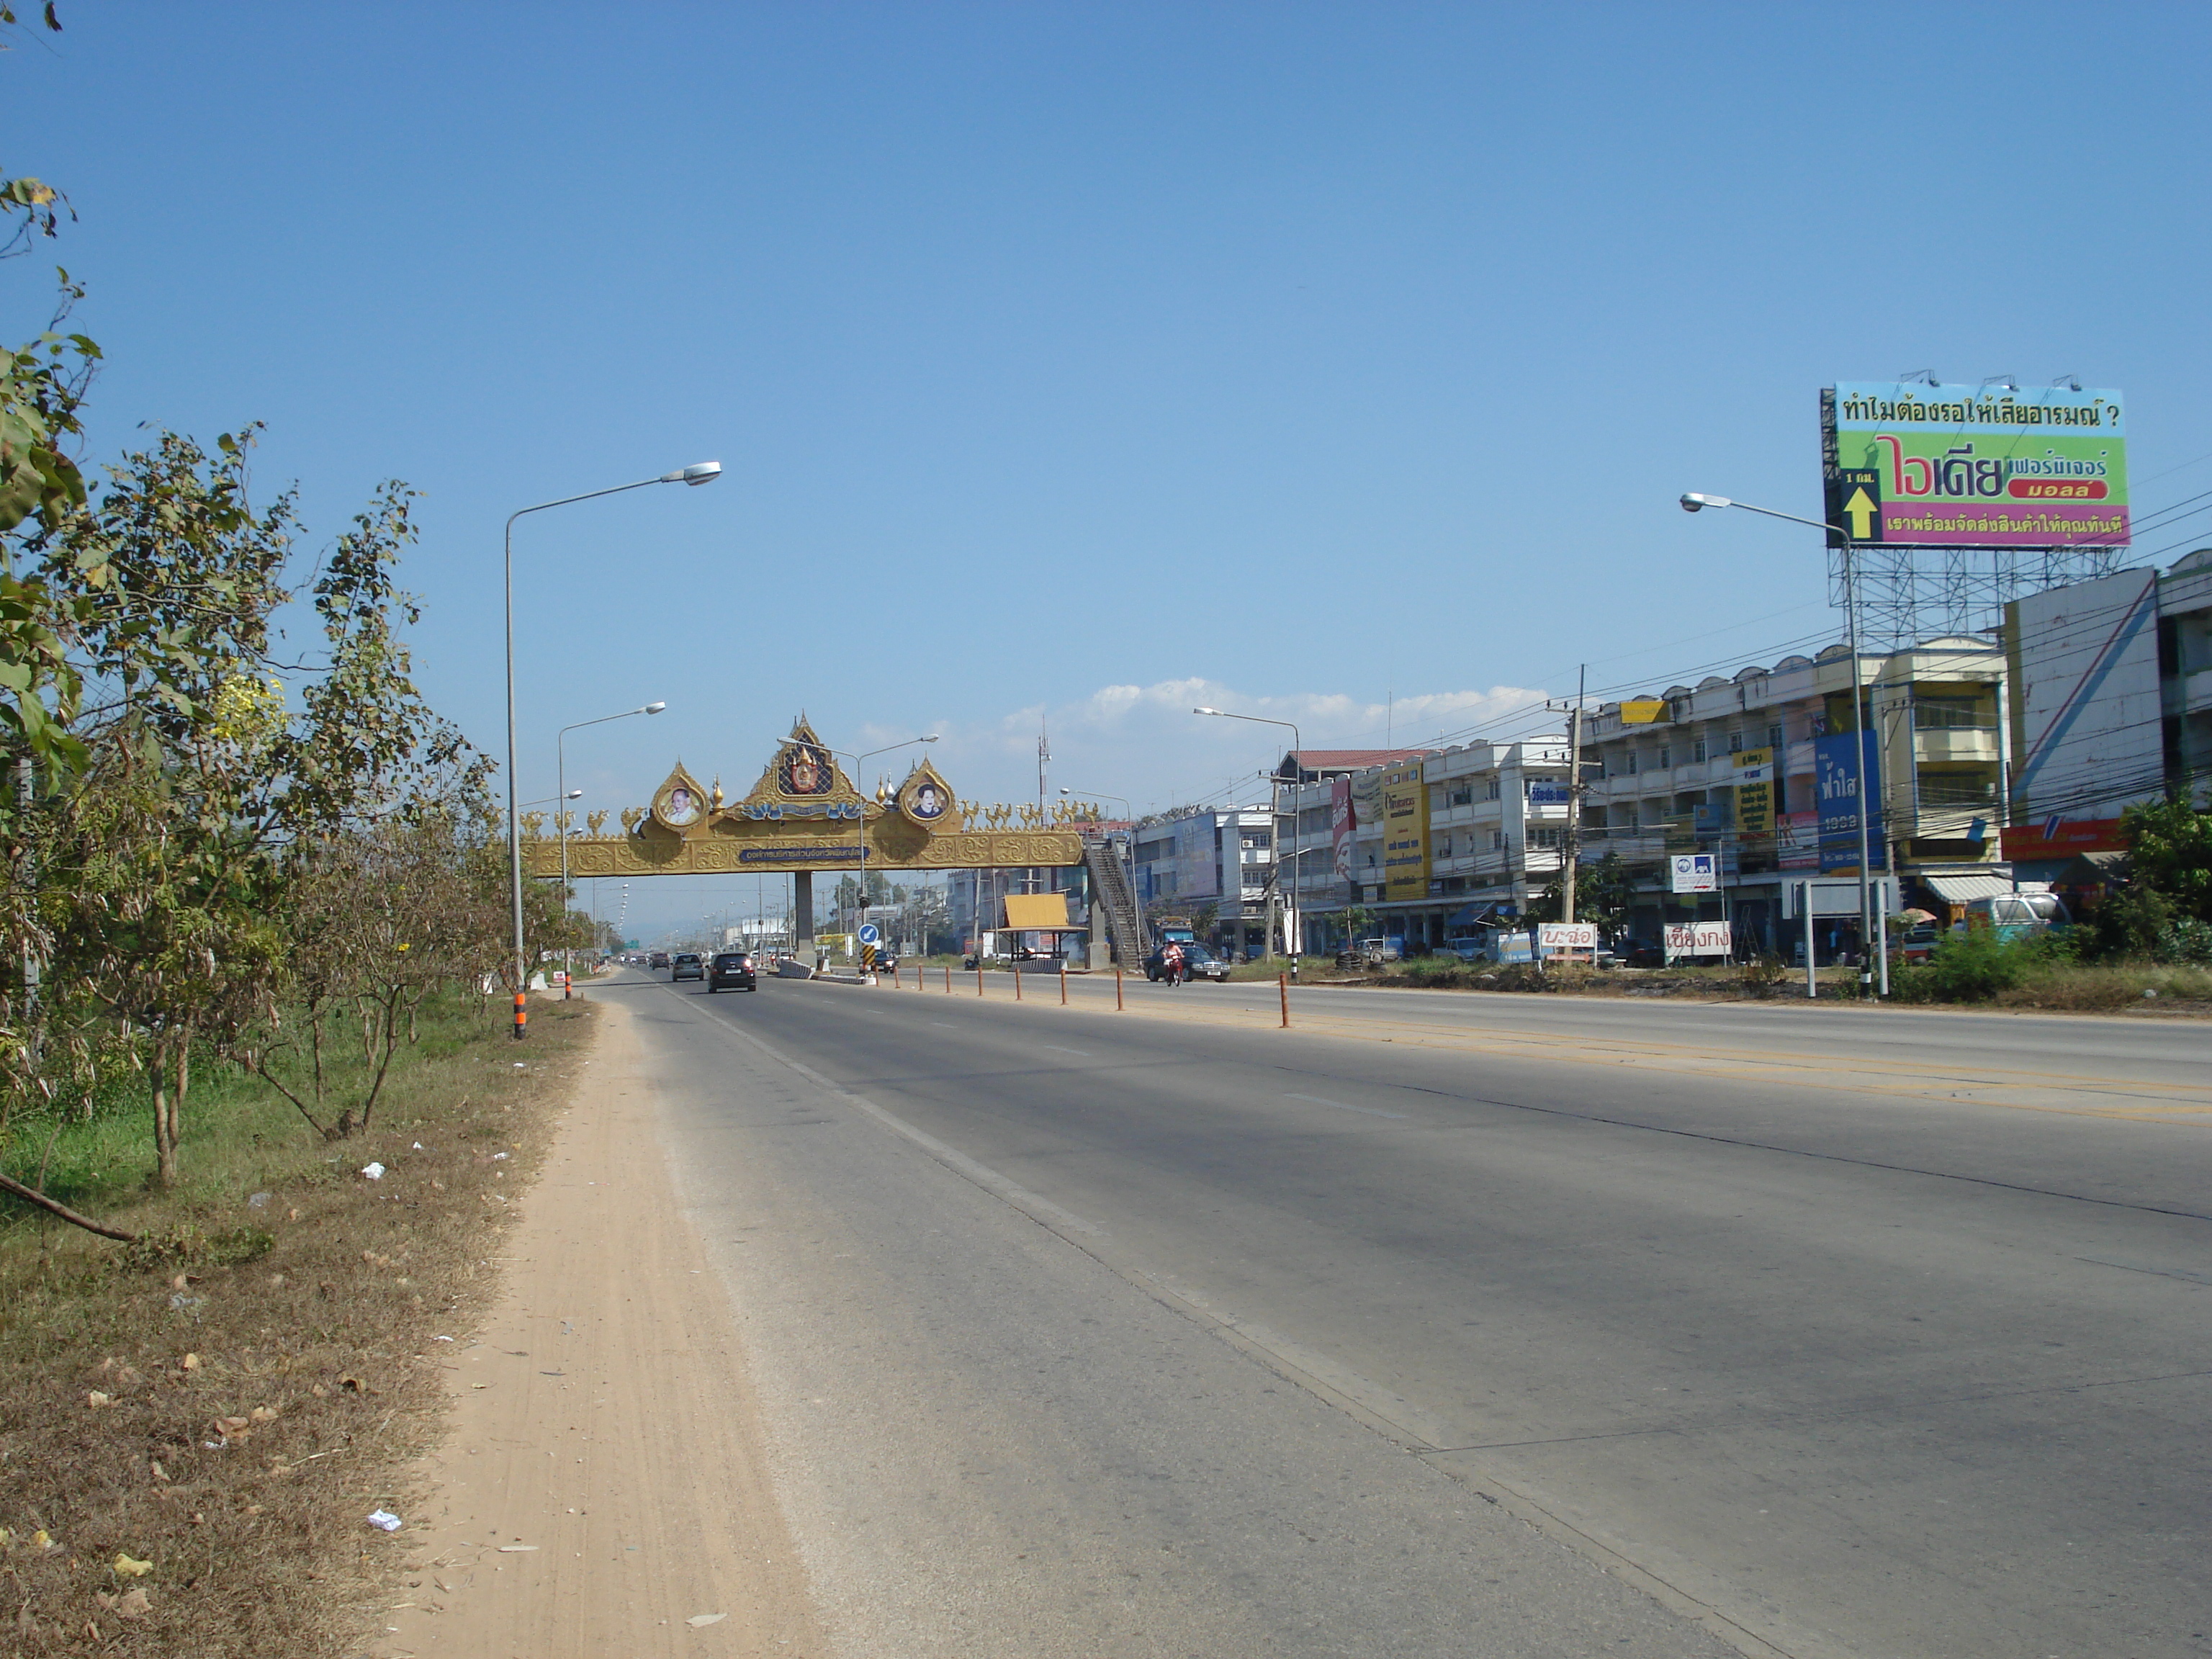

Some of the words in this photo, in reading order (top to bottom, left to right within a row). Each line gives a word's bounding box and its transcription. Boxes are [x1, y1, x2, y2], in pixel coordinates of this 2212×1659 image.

[1843, 392, 2105, 427] ทำไมต้องรอให้เสียอารมณ์
[1875, 435, 2003, 497] ไอเดีย
[2008, 450, 2107, 476] เฟอร์นิเจอร์
[1846, 474, 1853, 483] 1
[2027, 480, 2094, 498] มอลล์
[1887, 511, 2123, 540] เราพร้อมจัดส่งสินค้าให้คุณทันที
[1821, 761, 1858, 800] ฟ้าใส
